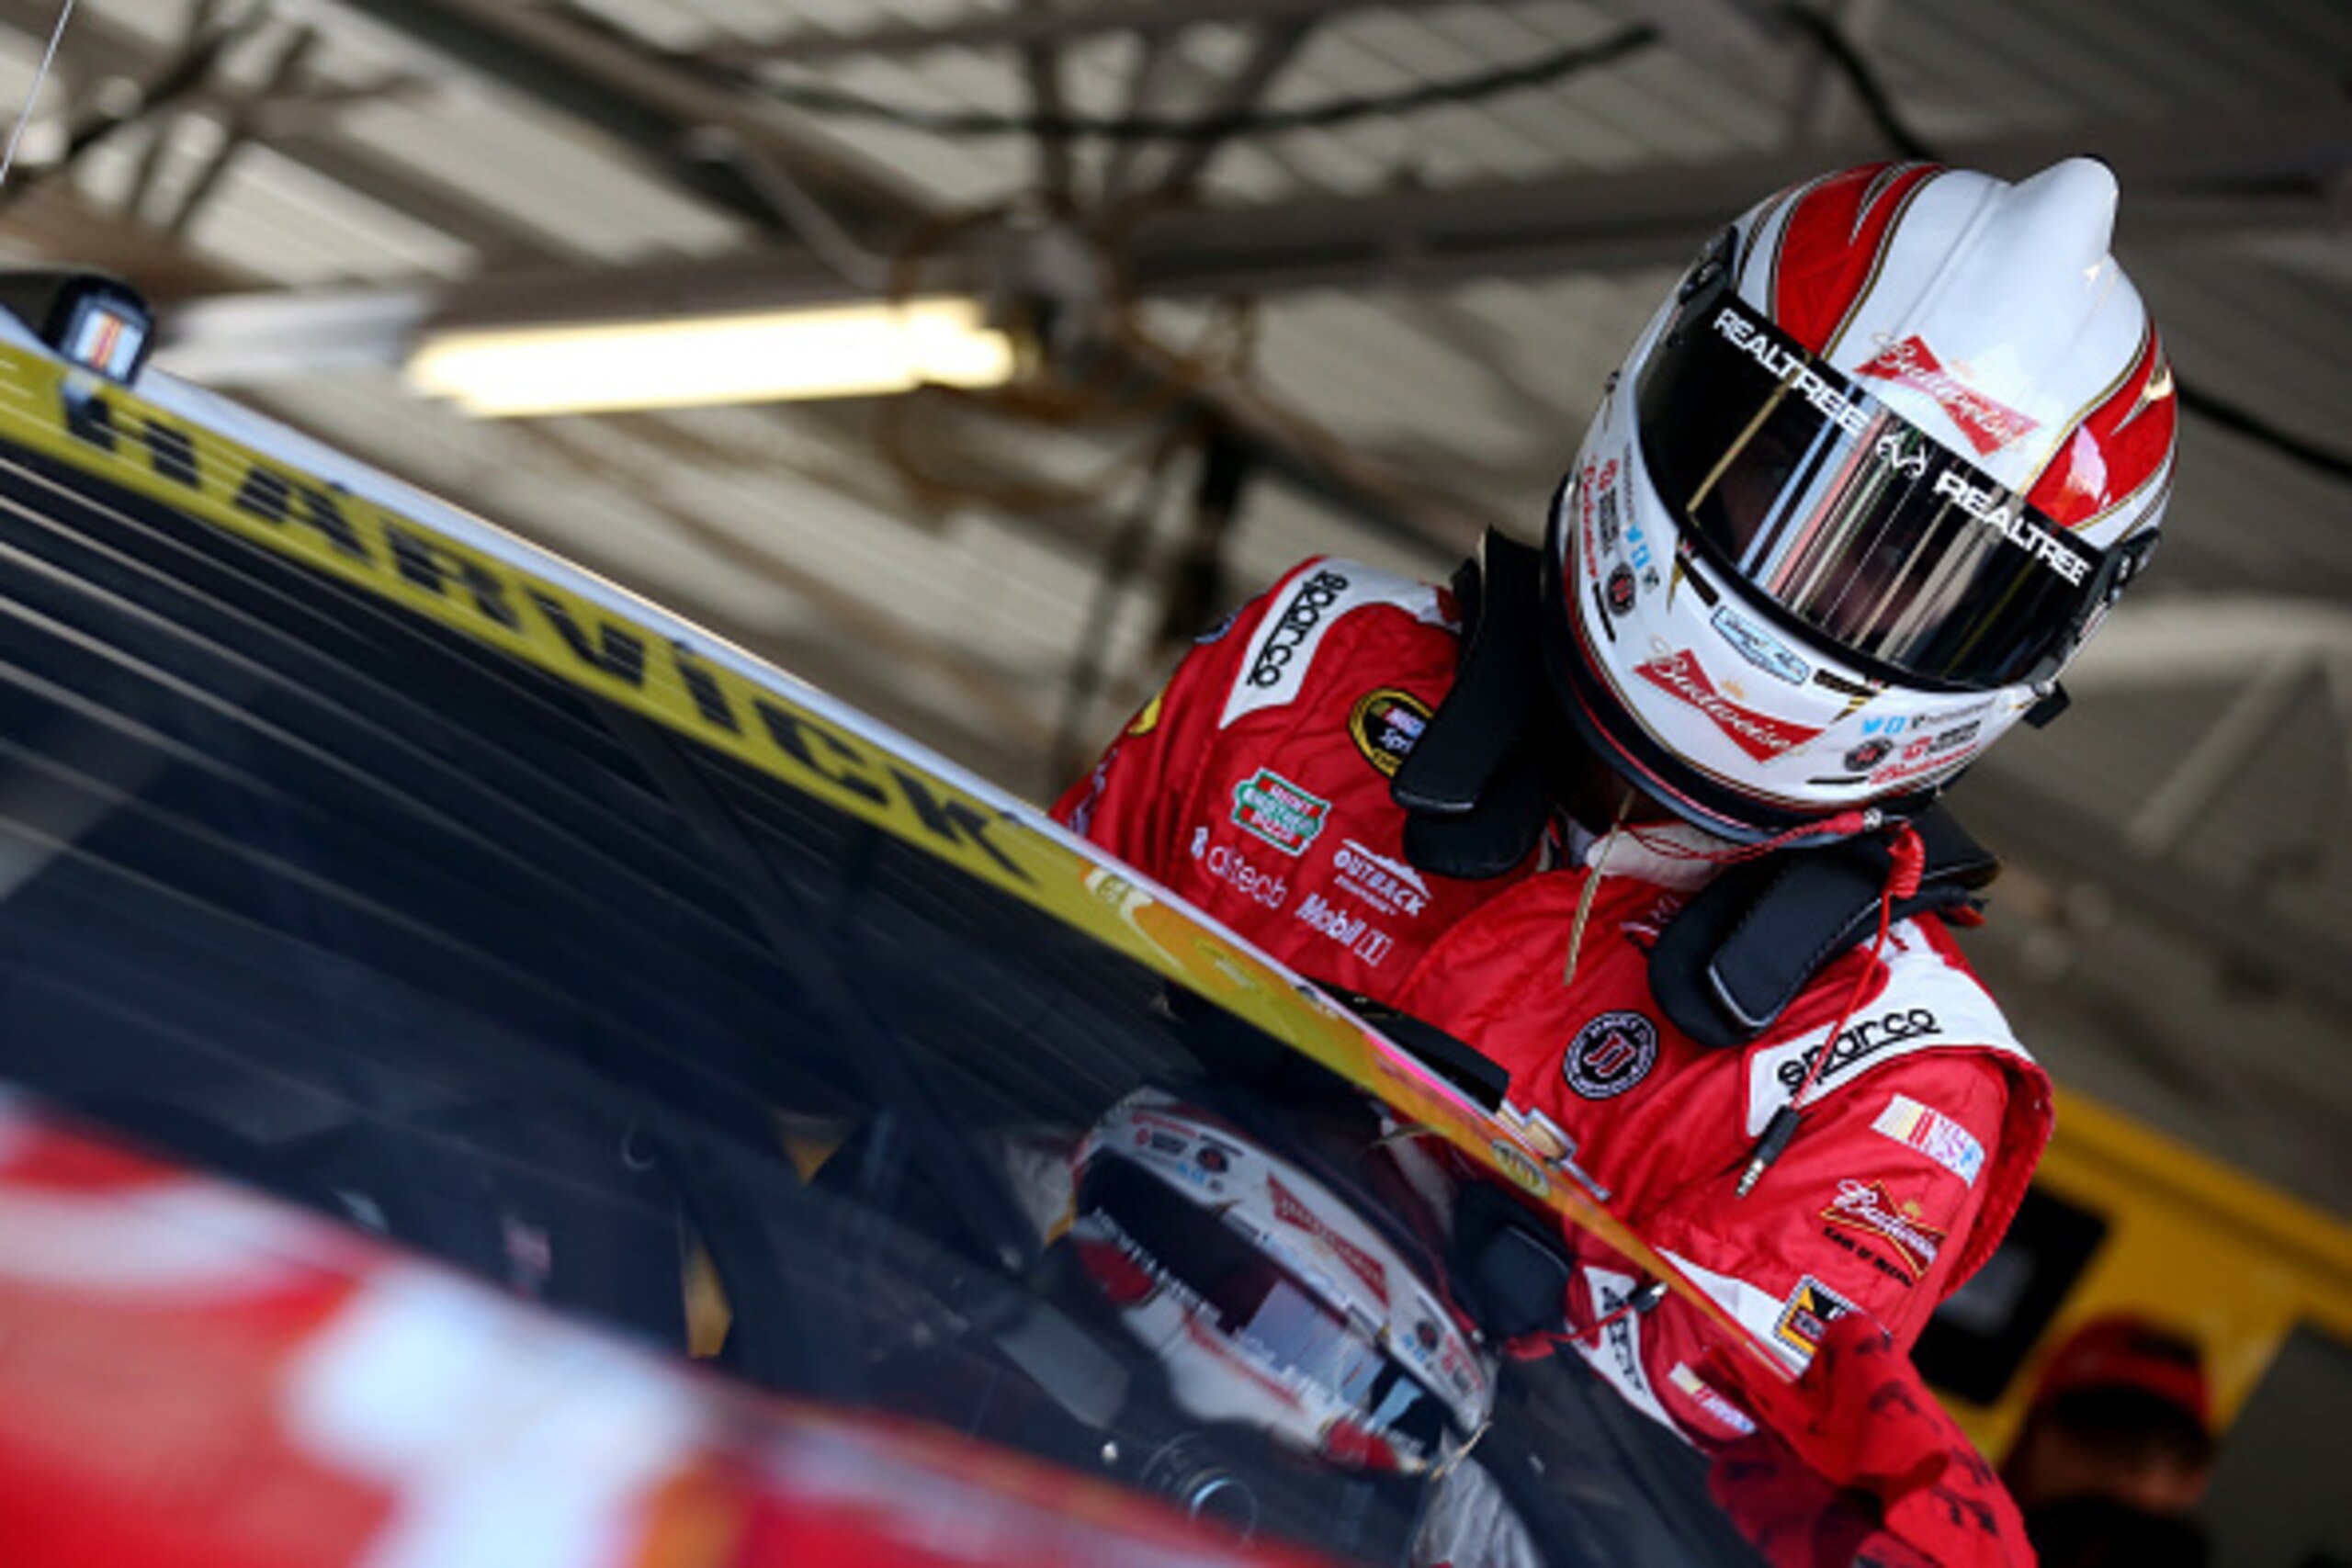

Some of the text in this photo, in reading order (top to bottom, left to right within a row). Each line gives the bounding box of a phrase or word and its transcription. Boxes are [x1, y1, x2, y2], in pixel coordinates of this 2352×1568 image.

[1713, 308, 1871, 437] REALTREE
[1932, 469, 2093, 587] REALTREE
[61, 370, 1034, 885] HARVICK
[1246, 570, 1350, 689] sparco
[1643, 632, 1811, 757] Budweiser
[1294, 891, 1367, 947] Mobil
[1333, 849, 1426, 918] OUTBACK
[1777, 1008, 1942, 1098] sparco
